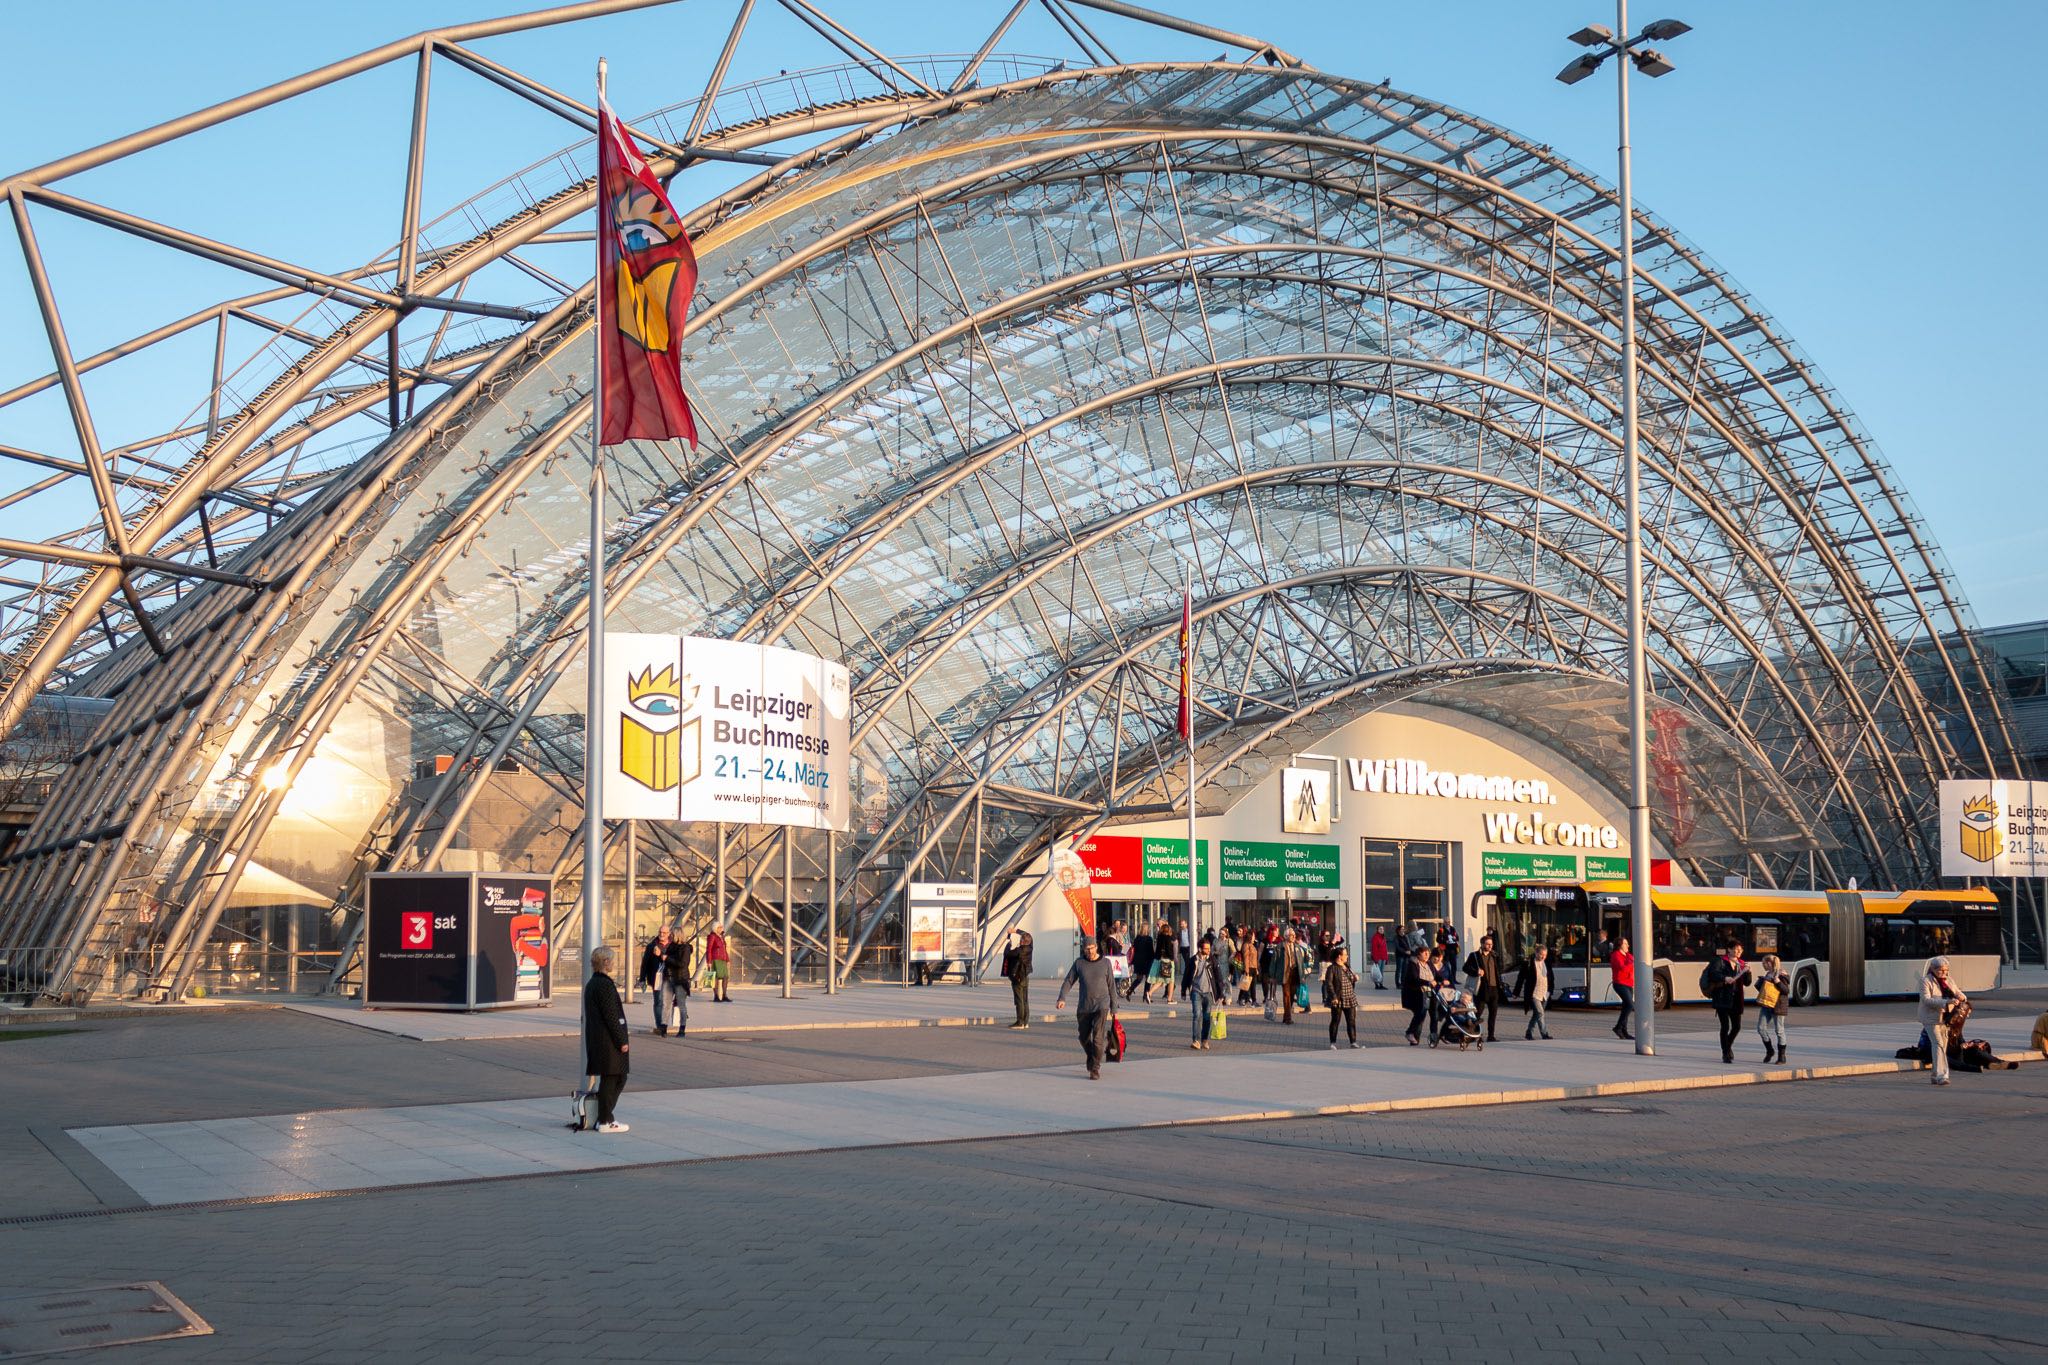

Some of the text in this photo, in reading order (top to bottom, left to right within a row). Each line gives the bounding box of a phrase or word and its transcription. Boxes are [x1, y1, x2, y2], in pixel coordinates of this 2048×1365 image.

[714, 686, 812, 721] Leipziger
[714, 720, 829, 755] Buchmesse
[795, 762, 829, 788] März
[1346, 758, 1557, 804] Willkommen.
[714, 793, 829, 810] www.leipziger-buchmesse.de
[2008, 804, 2048, 821] Leipzig
[1483, 812, 1624, 848] Welcome.
[2009, 822, 2048, 836] Buchm
[1146, 854, 1204, 866] Vorverkaufstiets
[1223, 857, 1278, 868] Vorverkaufstickets
[1285, 859, 1337, 870] Vorverkaufstickets
[1095, 867, 1112, 877] Desk
[1146, 869, 1168, 879] Online
[1223, 871, 1265, 881] Online Tickets
[1485, 866, 1528, 876] Vorverkaufstickets
[1533, 868, 1575, 877] Vorverkaufstickets
[1587, 869, 1627, 879] Vorverkaufstickets
[1285, 873, 1325, 883] Online Tickets
[1519, 888, 1552, 899] S-Bahnhof
[1554, 888, 1575, 900] Messe
